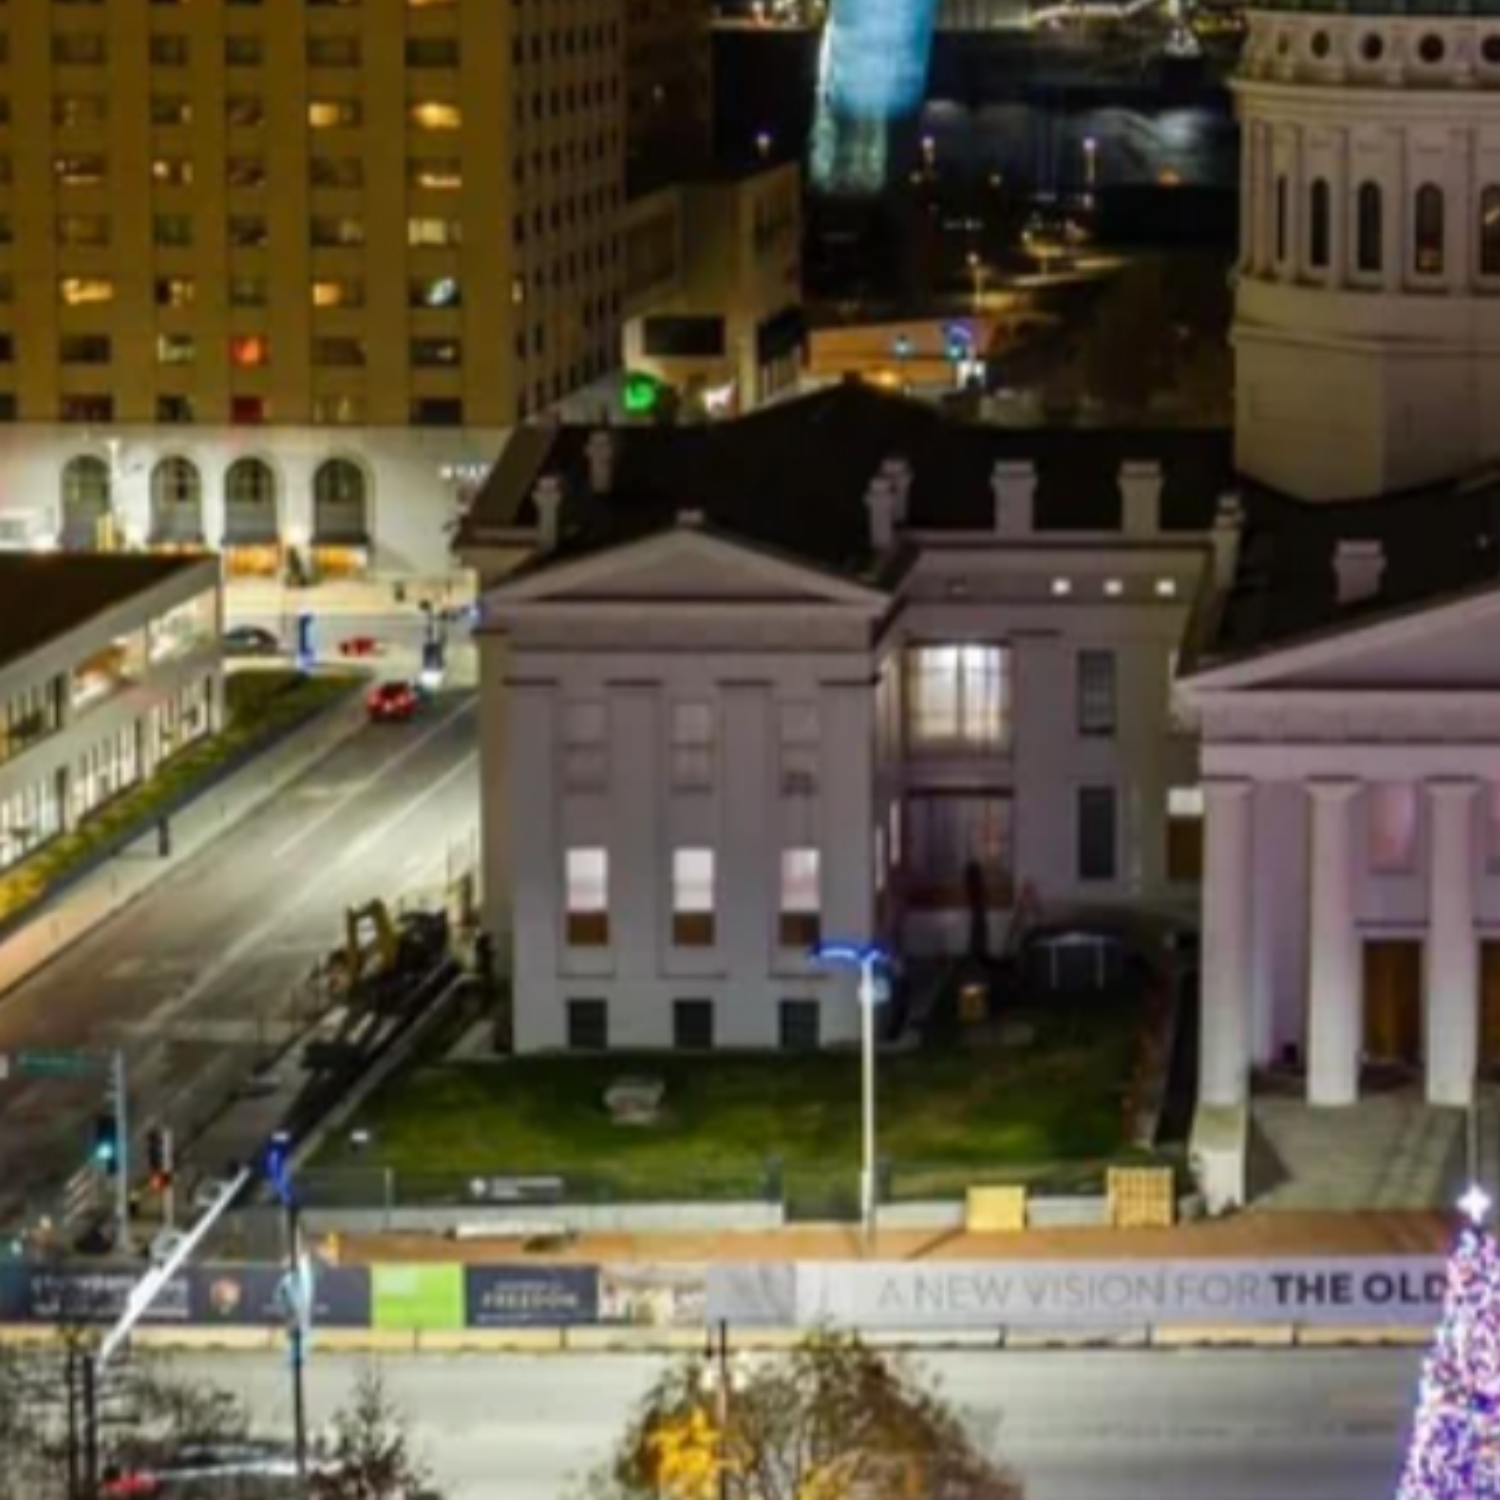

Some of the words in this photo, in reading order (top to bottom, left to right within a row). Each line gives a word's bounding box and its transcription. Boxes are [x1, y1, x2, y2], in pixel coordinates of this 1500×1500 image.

[876, 1275, 909, 1309] A
[914, 1273, 1014, 1310] NEW
[1022, 1271, 1165, 1308] VISION
[1174, 1270, 1264, 1305] FOR
[1270, 1270, 1355, 1305] THE
[1361, 1270, 1452, 1305] OLD
